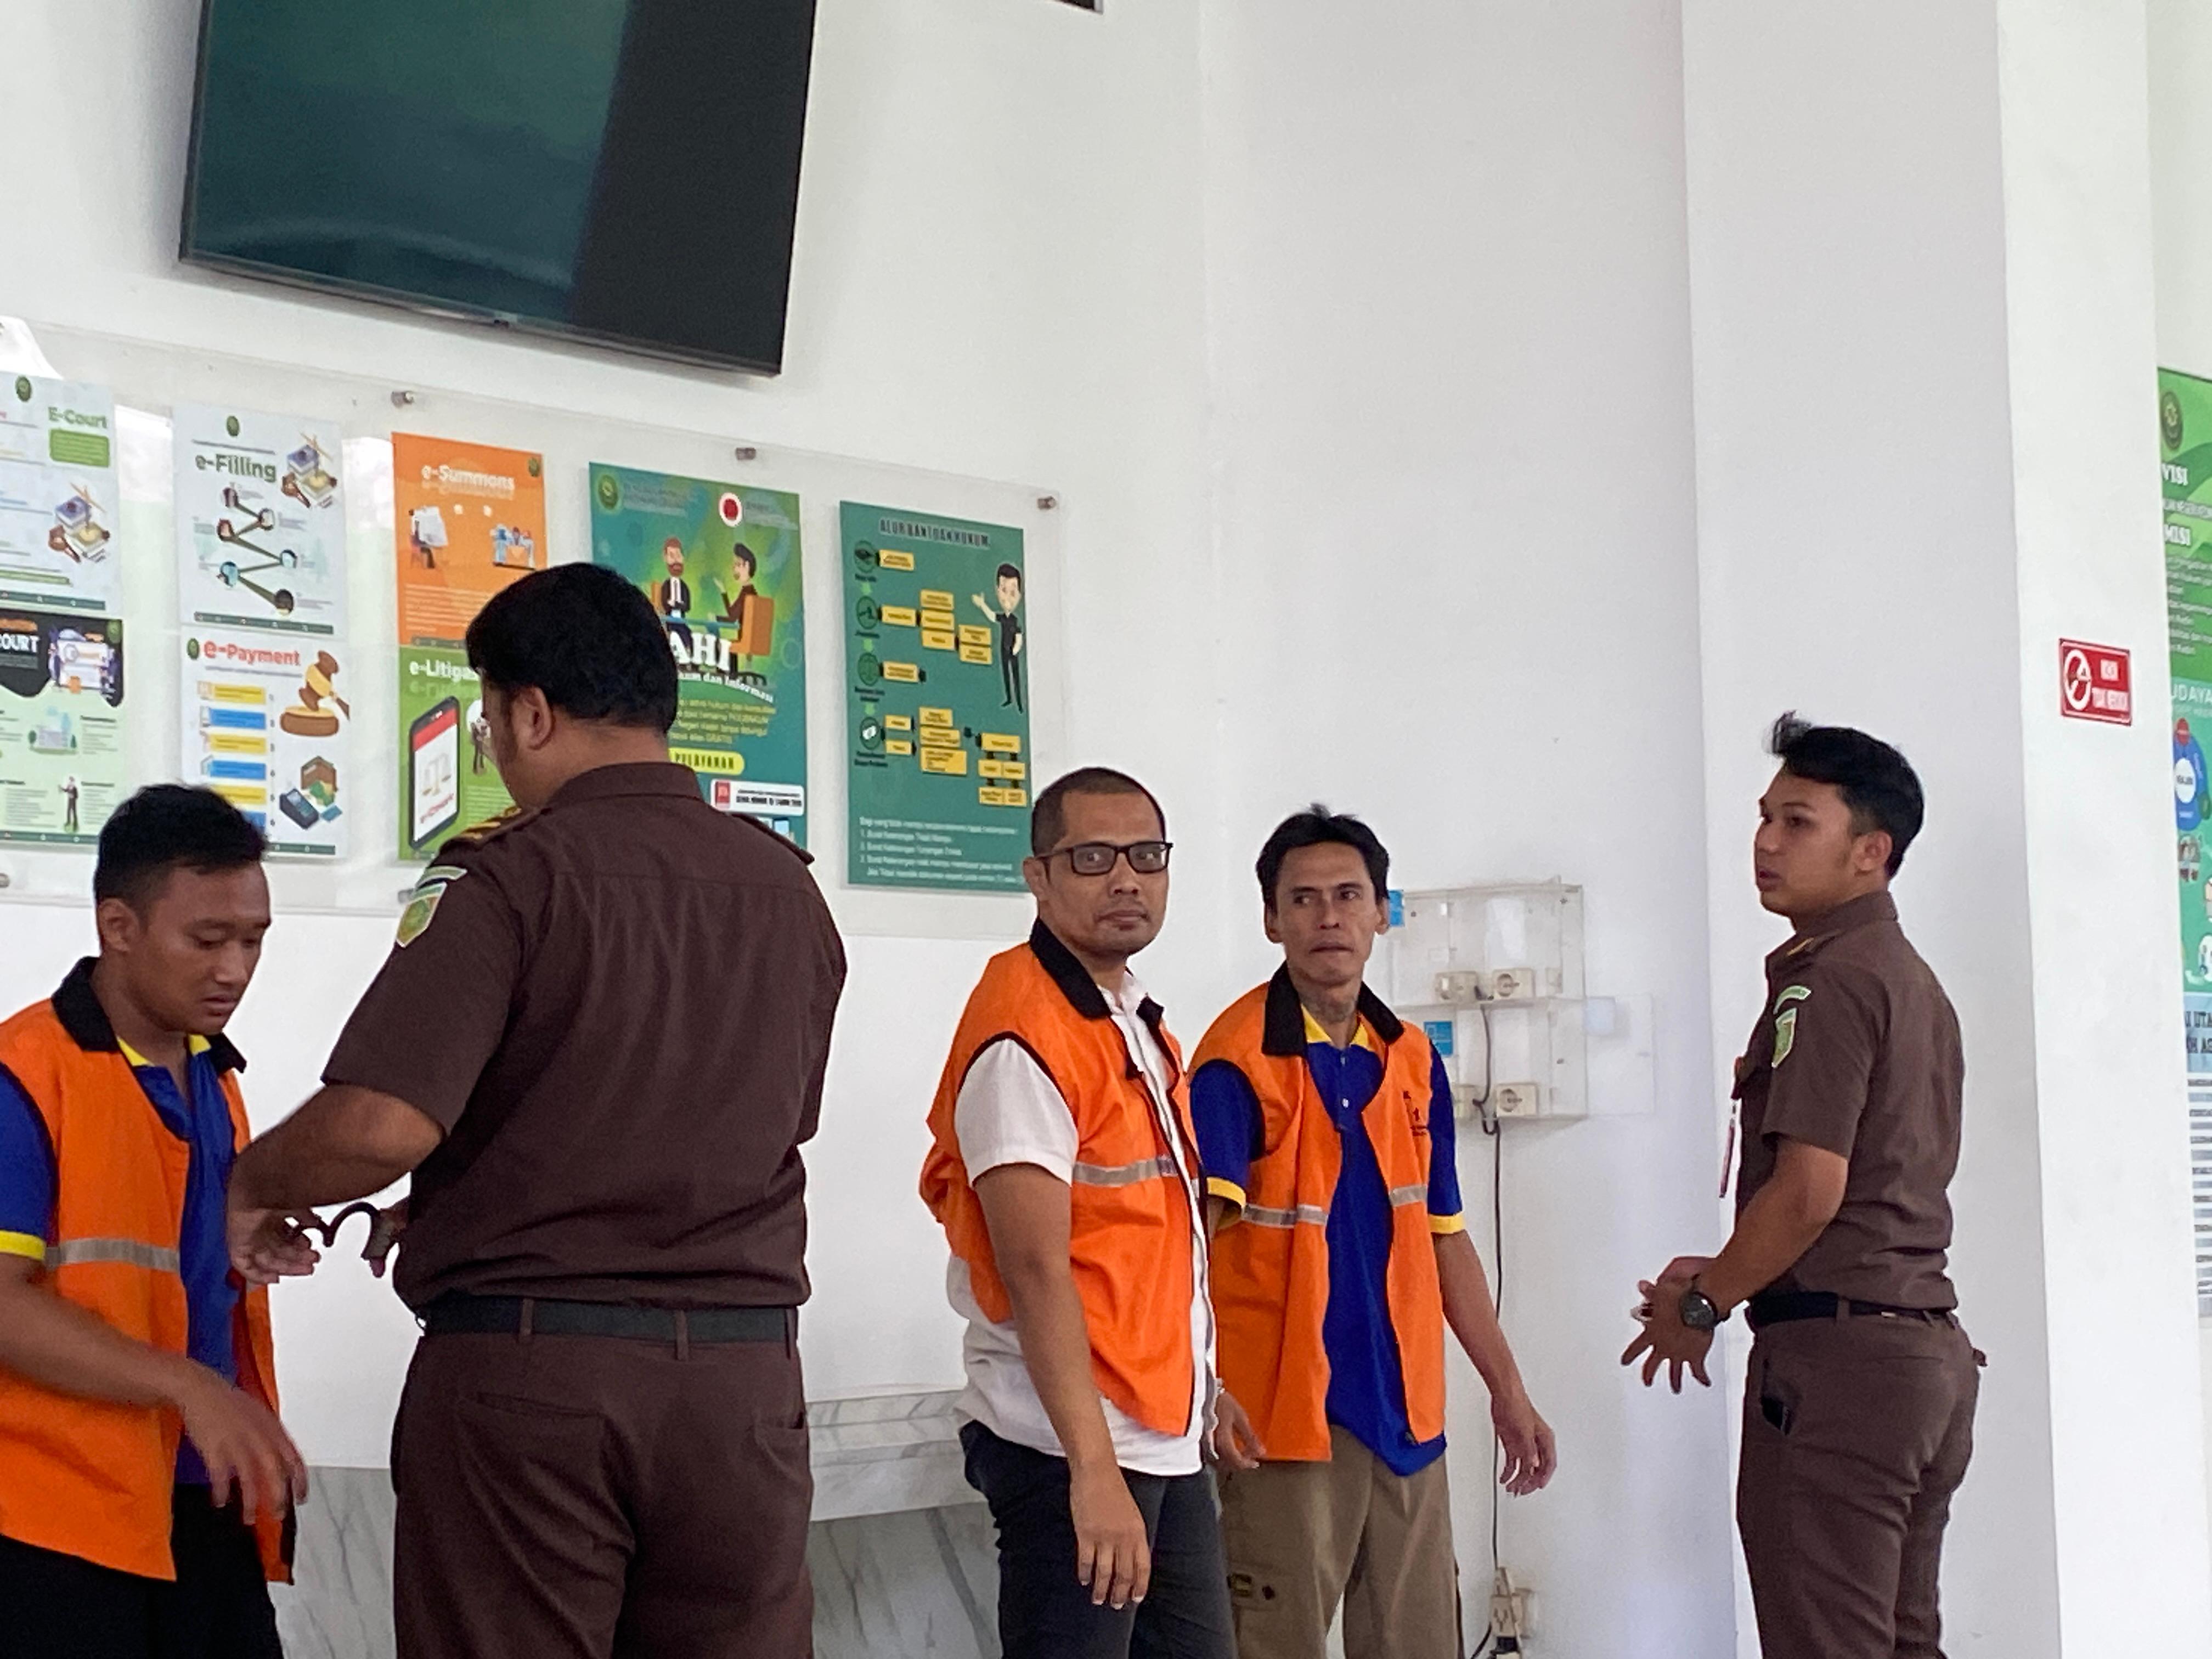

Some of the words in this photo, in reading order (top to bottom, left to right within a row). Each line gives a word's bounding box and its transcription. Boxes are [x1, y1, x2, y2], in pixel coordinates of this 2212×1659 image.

[48, 407, 108, 428] E-Court
[195, 454, 276, 483] e-Filling
[421, 464, 515, 490] e-Summons
[0, 632, 40, 653] OURT
[204, 640, 301, 666] e-Payment
[724, 674, 774, 704] Informasi
